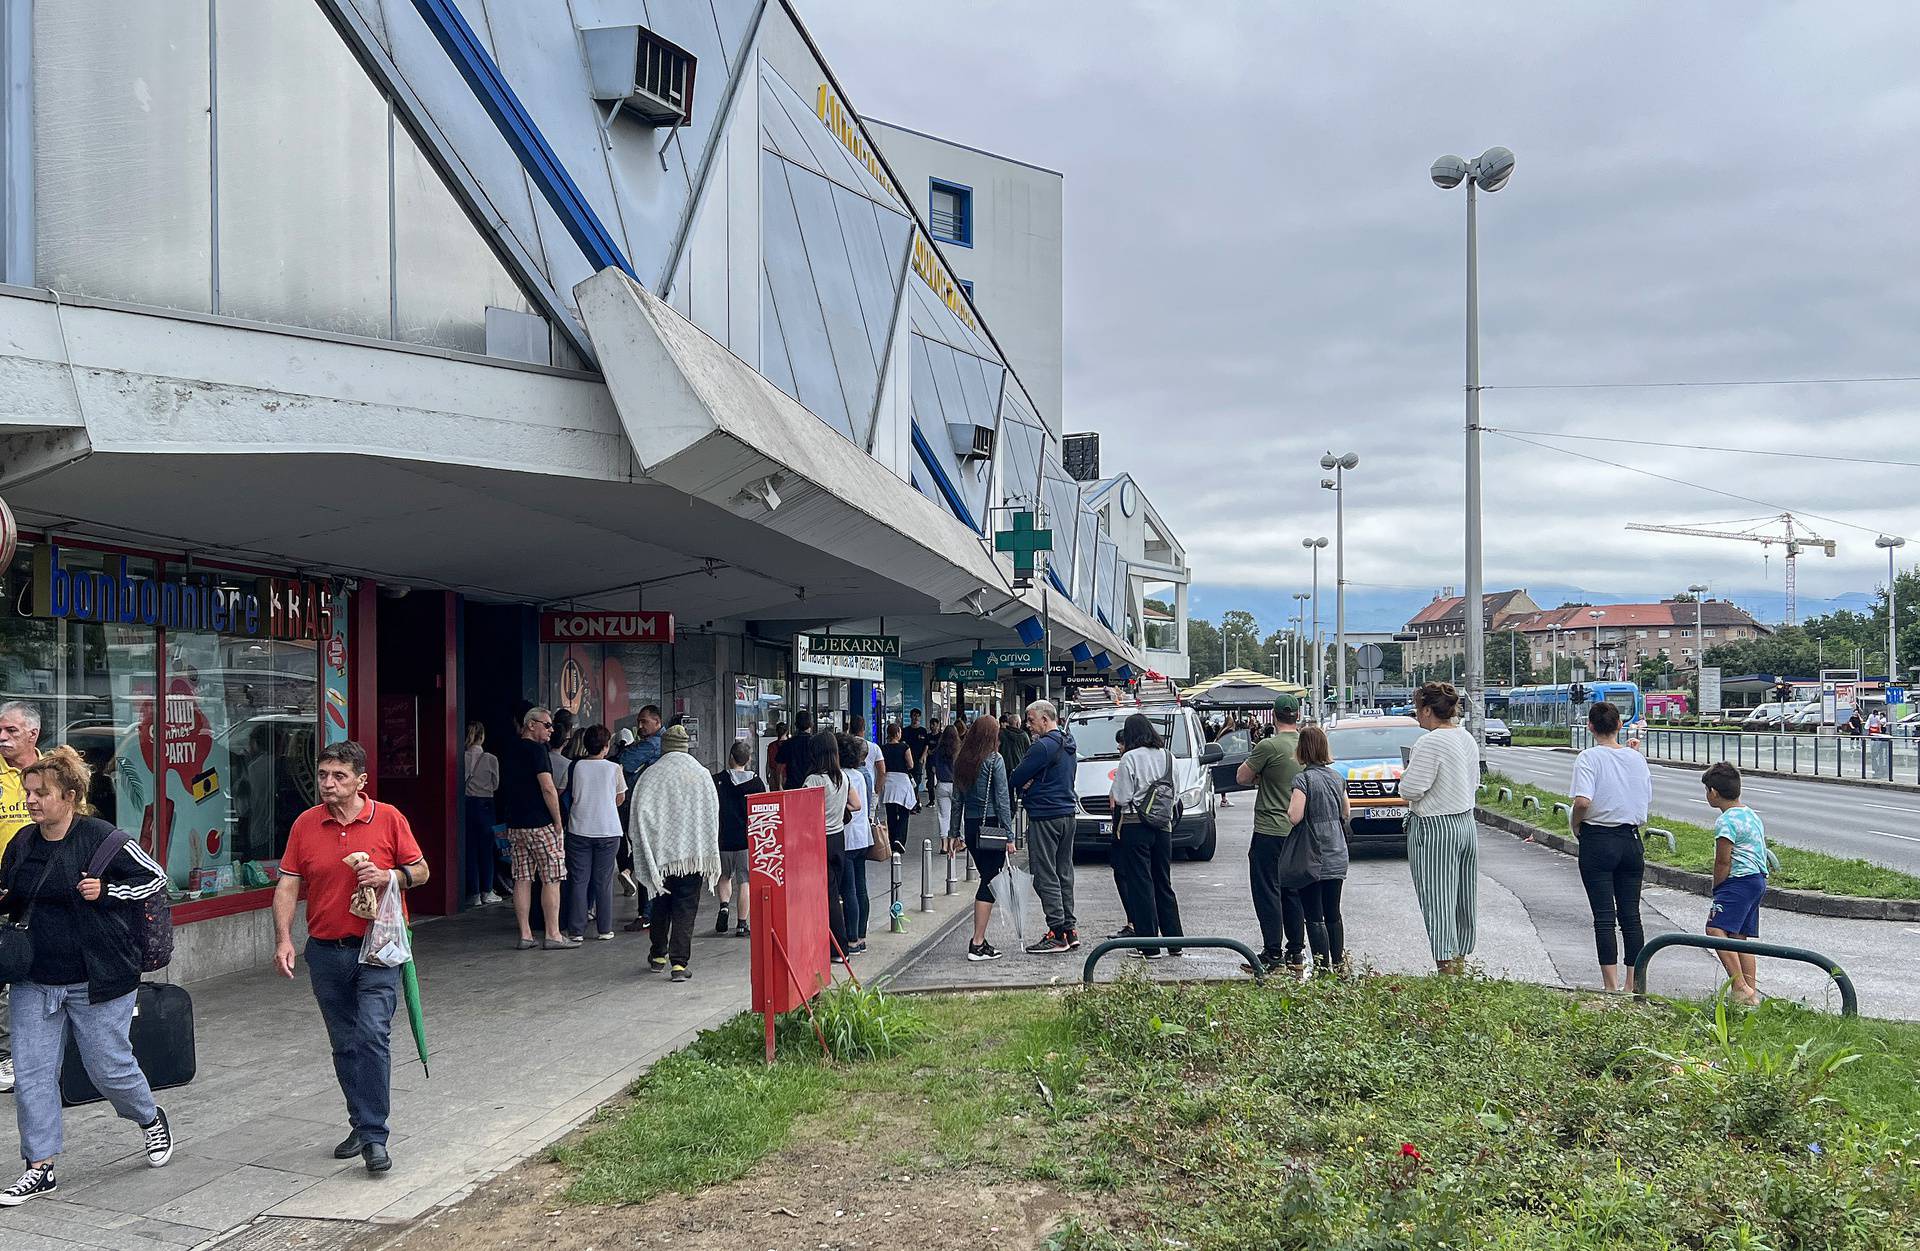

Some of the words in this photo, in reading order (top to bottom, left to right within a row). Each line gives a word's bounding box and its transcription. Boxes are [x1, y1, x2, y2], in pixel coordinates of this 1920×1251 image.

[554, 616, 656, 636] KONZUM
[811, 637, 896, 653] LJEKARNA
[1000, 652, 1031, 662] arriva
[959, 669, 985, 677] arriva
